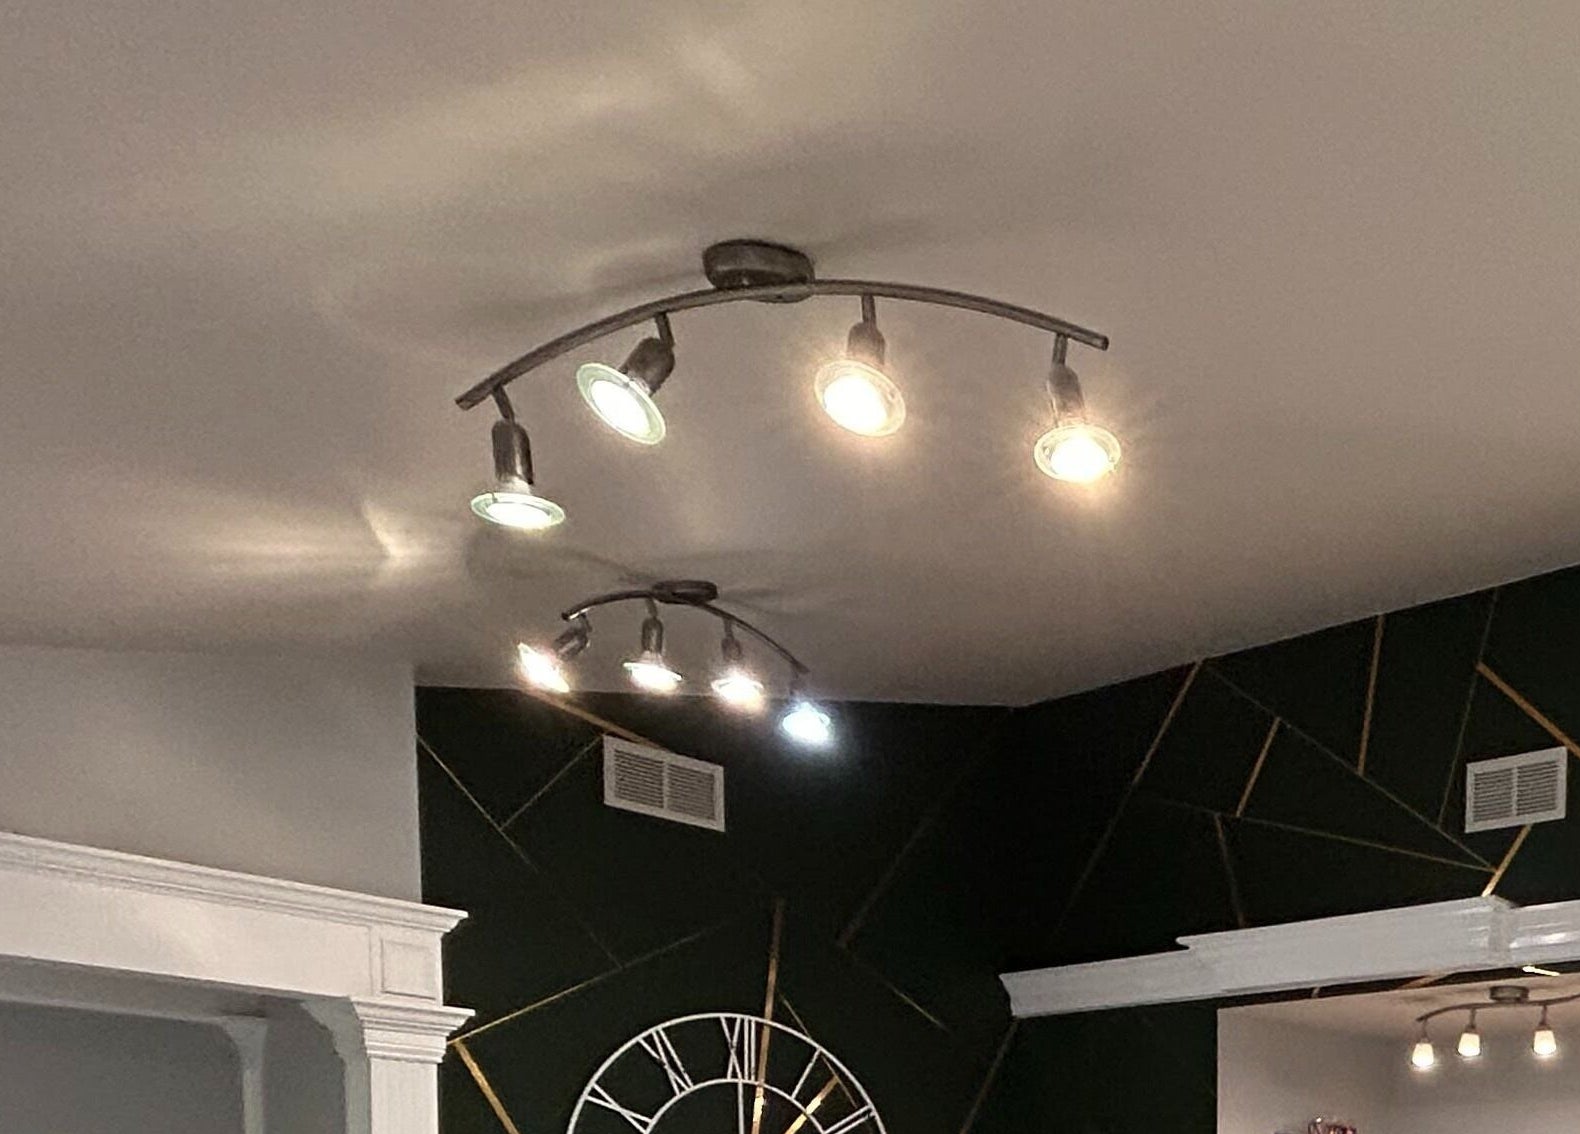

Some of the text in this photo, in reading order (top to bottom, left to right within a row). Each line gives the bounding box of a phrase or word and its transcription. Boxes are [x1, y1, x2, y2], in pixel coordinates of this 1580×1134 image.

[636, 1026, 695, 1098] XI
[719, 1015, 756, 1082] XII
[790, 1047, 821, 1100] I
